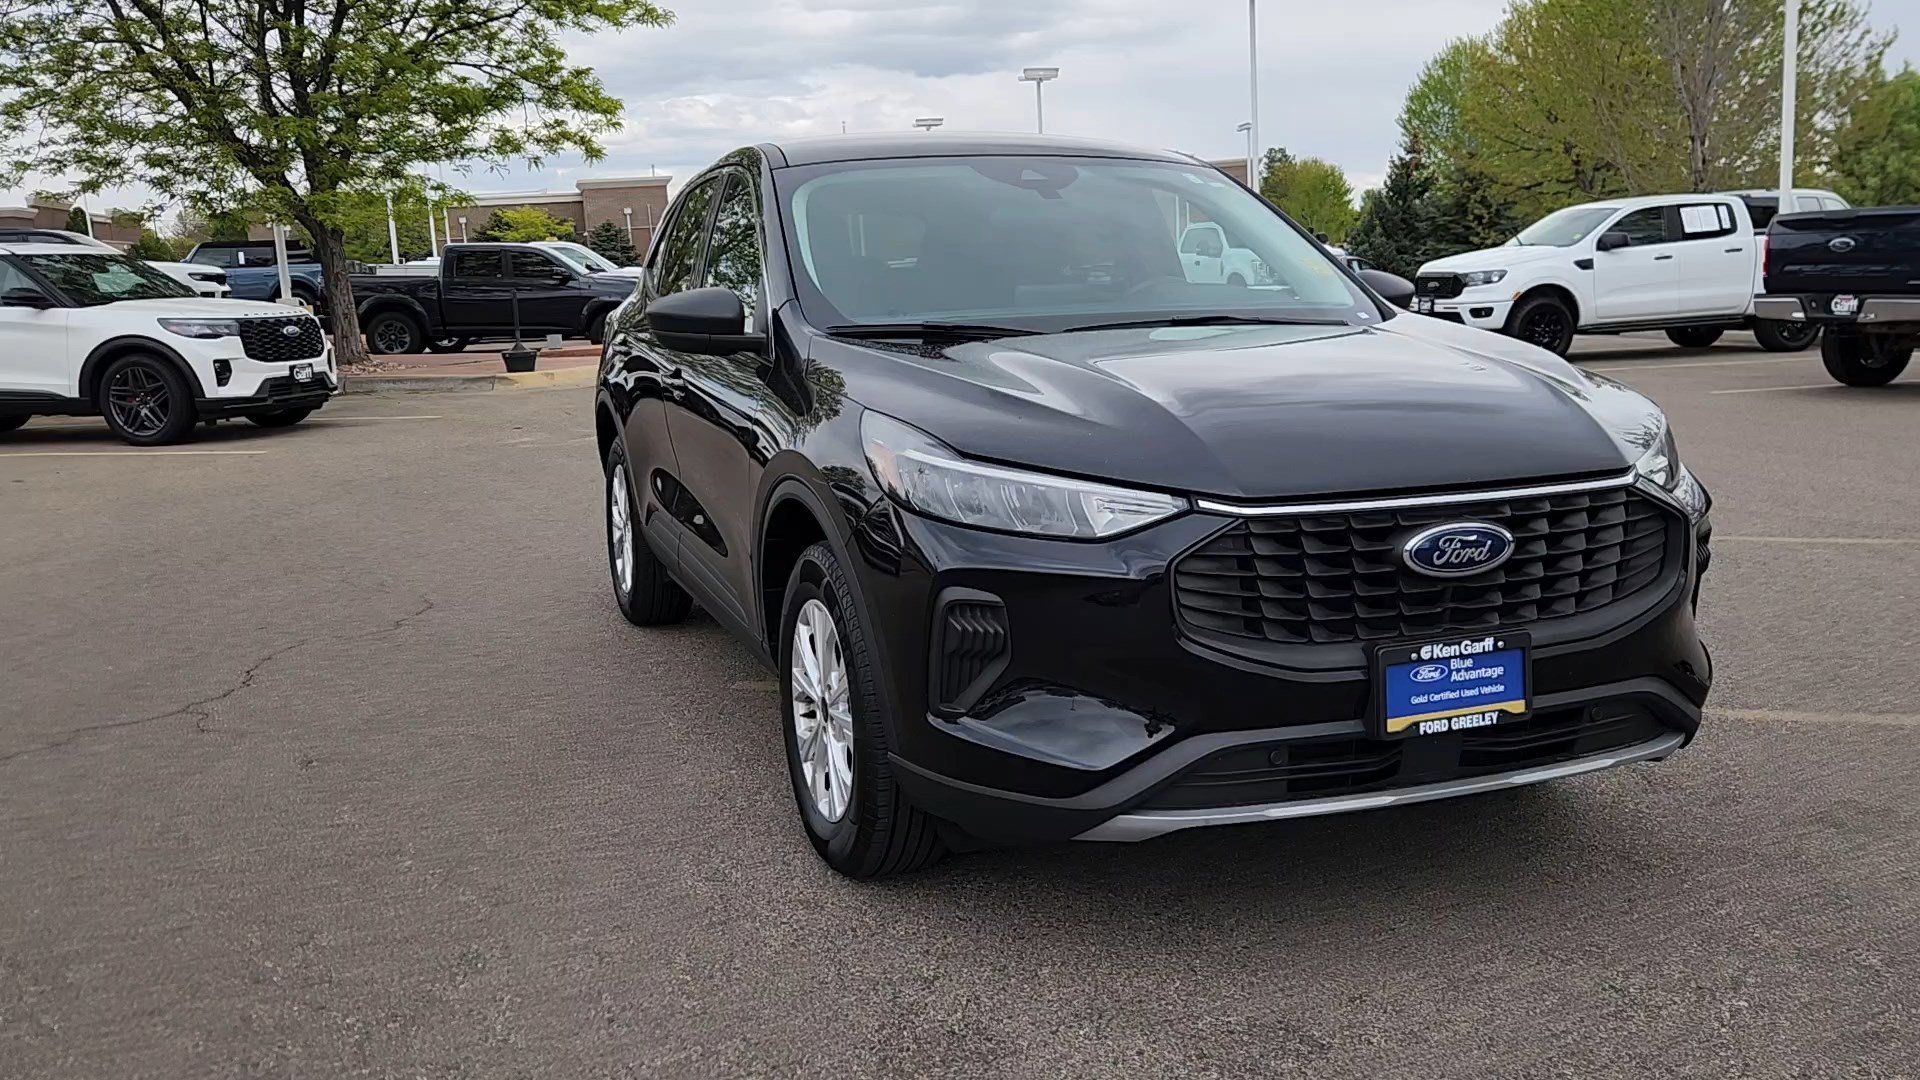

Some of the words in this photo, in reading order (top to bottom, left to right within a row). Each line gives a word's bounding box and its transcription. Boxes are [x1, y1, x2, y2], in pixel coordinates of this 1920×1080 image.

[1433, 534, 1492, 566] Ford
[1433, 643, 1460, 660] Ken
[1460, 637, 1495, 656] Garff
[1416, 666, 1441, 680] Ford
[1450, 657, 1474, 670] Blue
[1450, 665, 1504, 683] Advantage
[1410, 693, 1428, 705] Gold
[1429, 690, 1460, 702] Certified
[1460, 686, 1480, 698] Used
[1480, 683, 1505, 695] Vehicle
[1419, 718, 1449, 736] FORD
[1450, 711, 1499, 731] GREELEY
